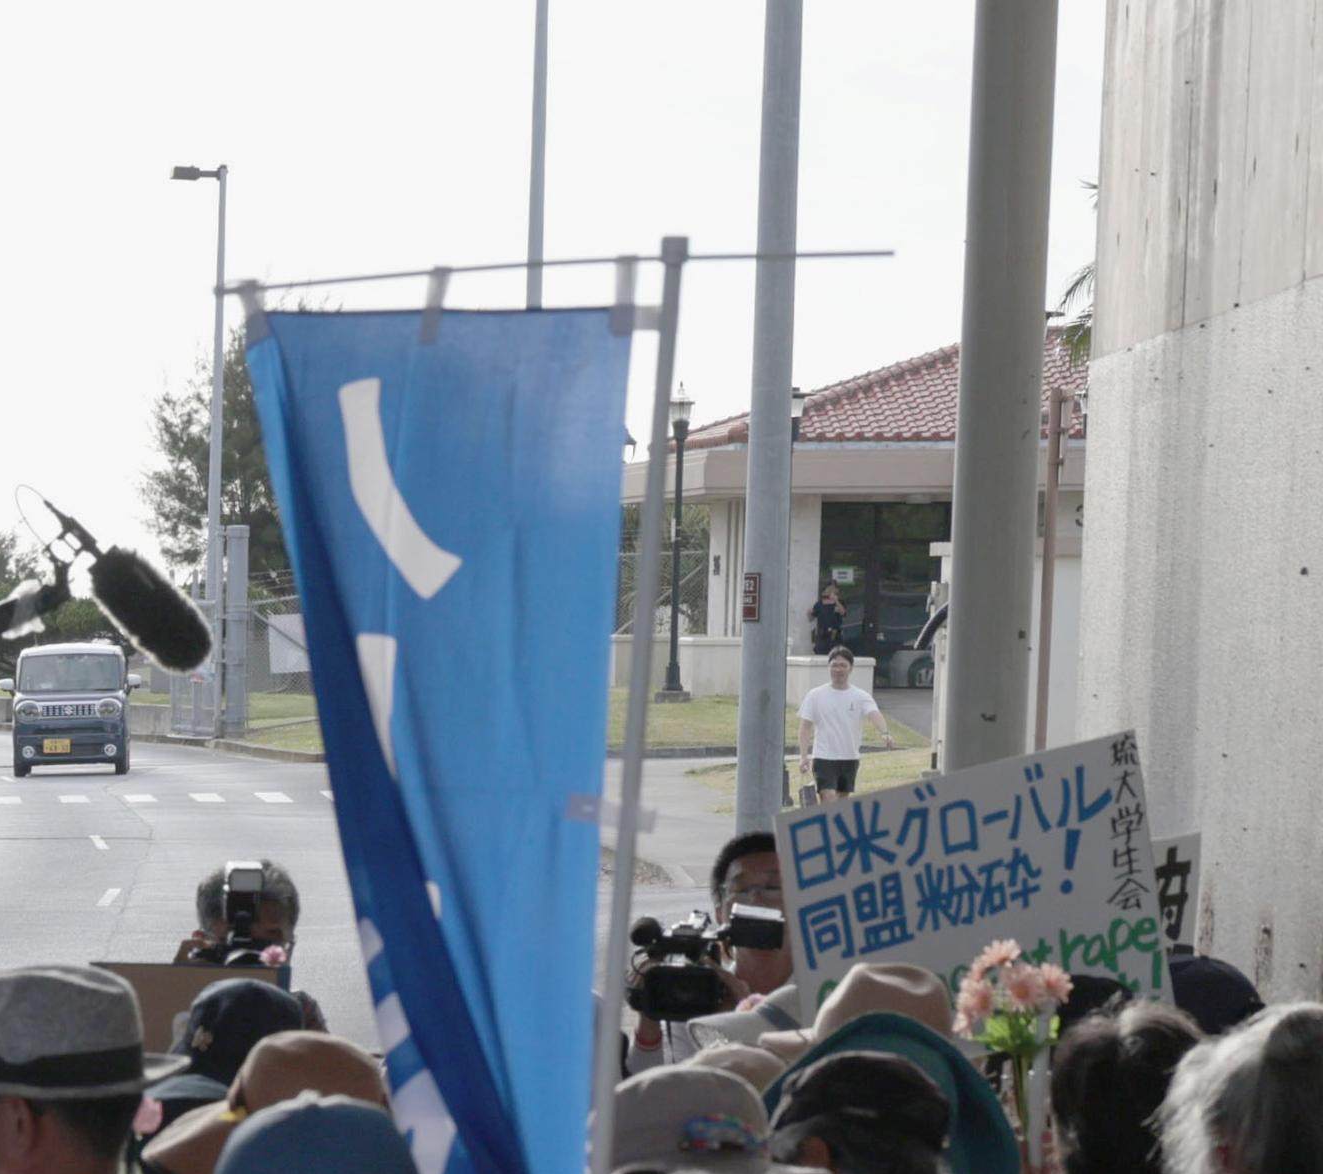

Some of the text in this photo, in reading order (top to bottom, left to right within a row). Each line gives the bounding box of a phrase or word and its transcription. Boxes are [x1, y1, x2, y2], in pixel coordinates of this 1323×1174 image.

[788, 763, 1114, 891] 日米グローバル
[1059, 917, 1159, 973] rape
